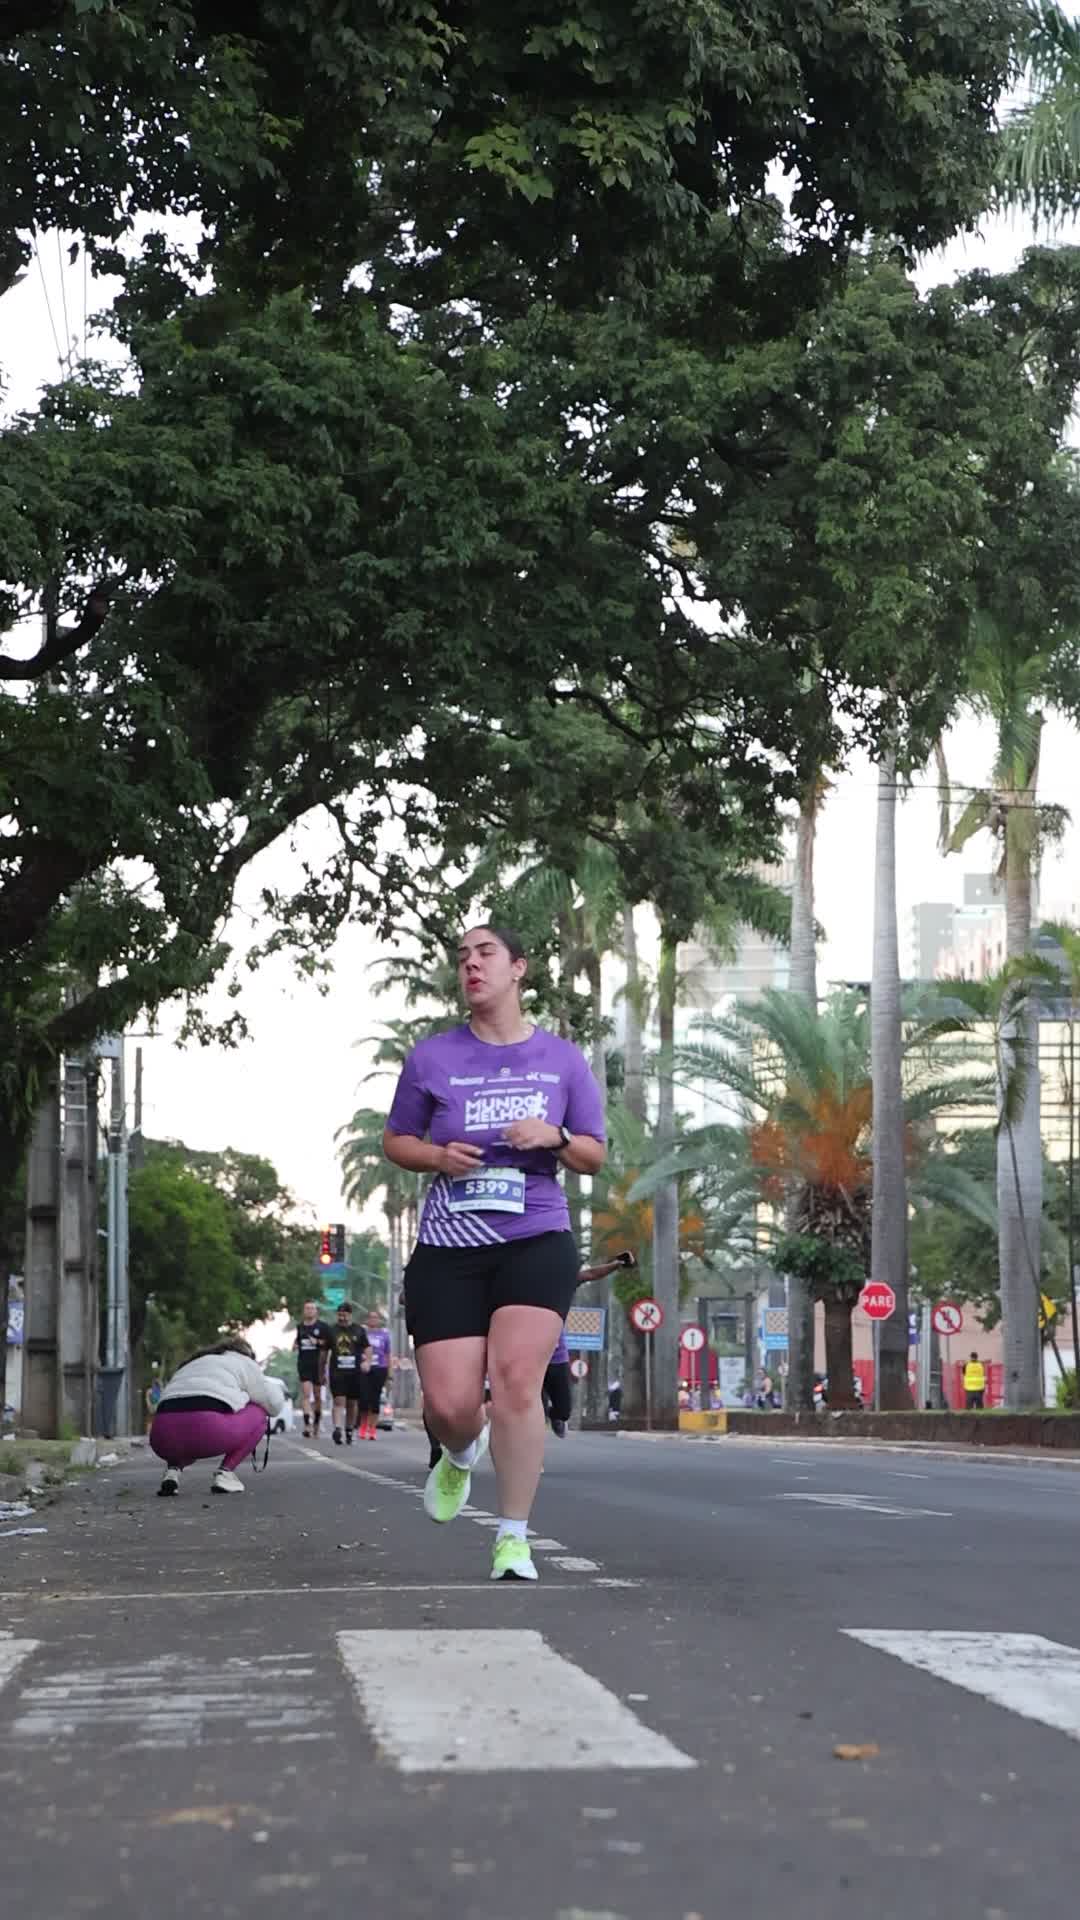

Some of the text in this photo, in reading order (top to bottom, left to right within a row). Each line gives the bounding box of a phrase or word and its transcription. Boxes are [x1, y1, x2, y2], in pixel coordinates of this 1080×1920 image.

[465, 1095, 536, 1113] MUNDO
[465, 1180, 508, 1194] 5399
[863, 1295, 893, 1308] PARE
